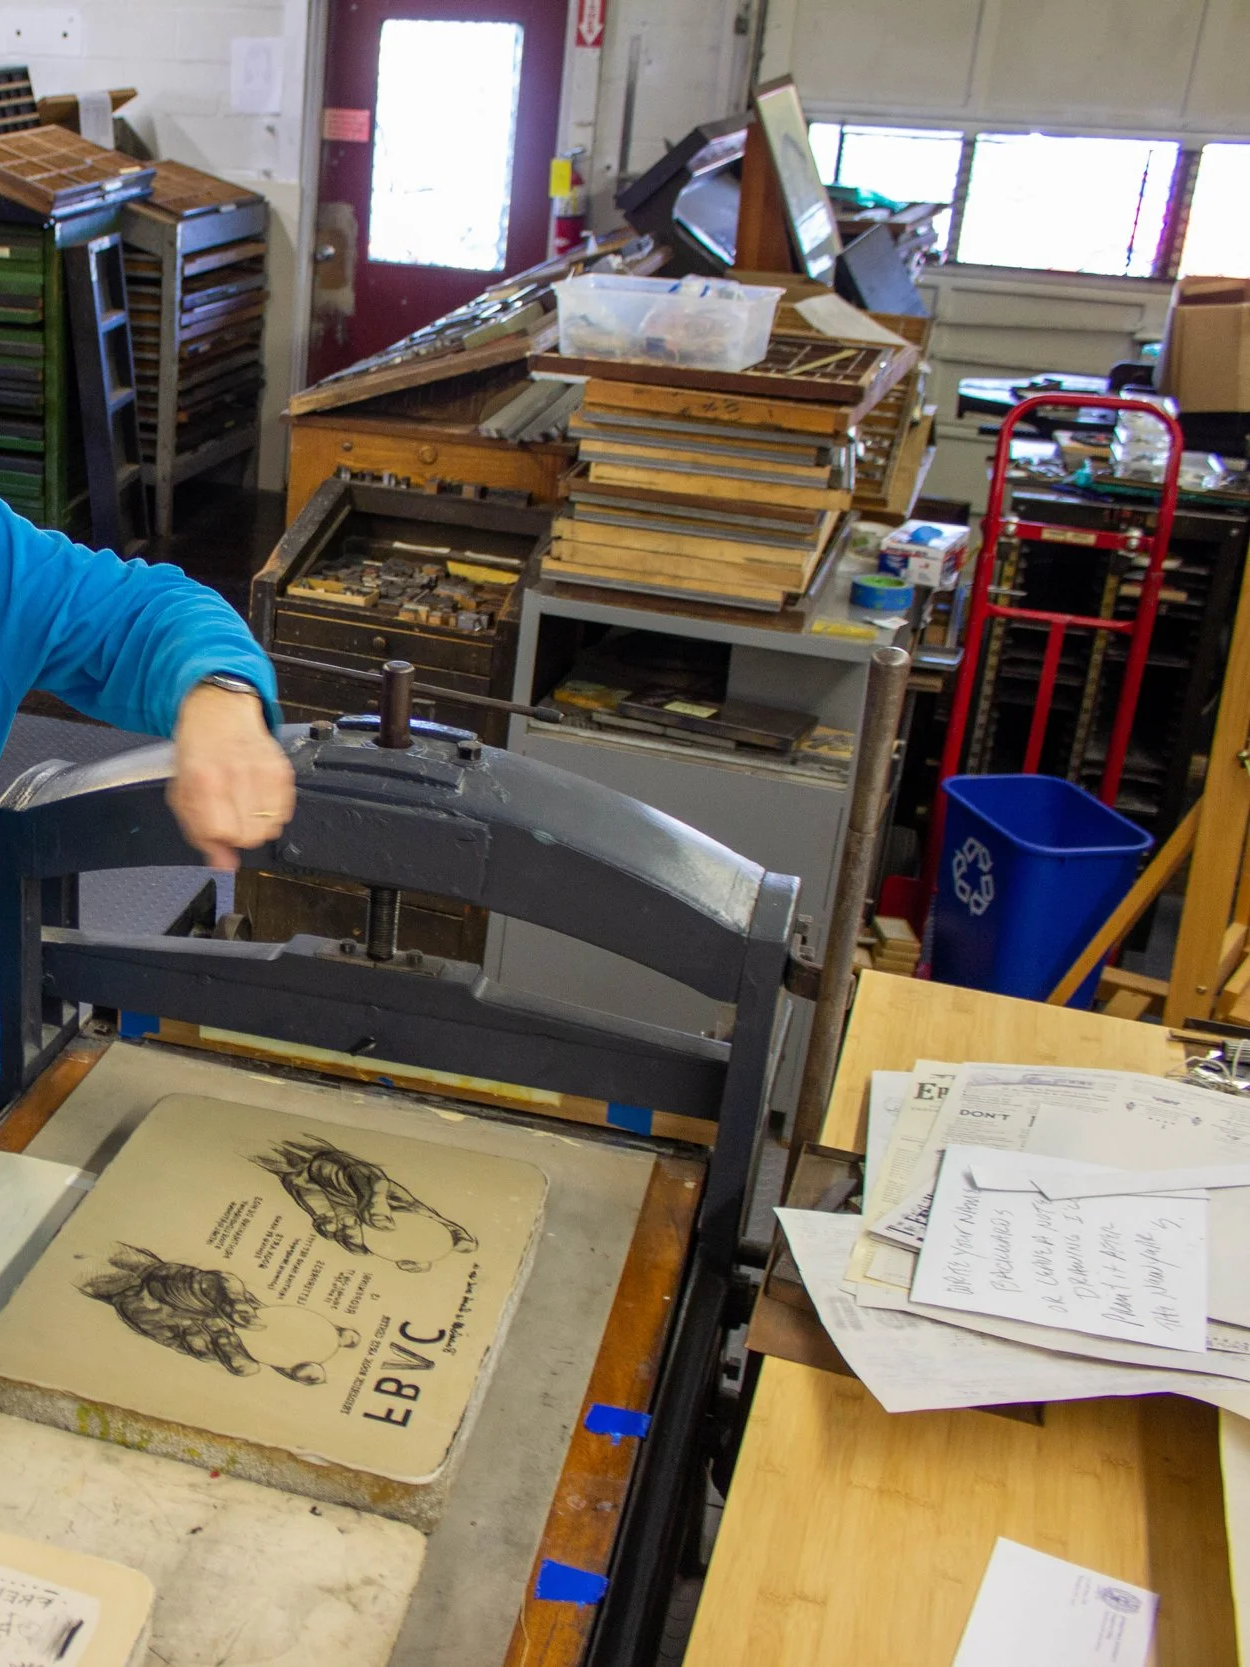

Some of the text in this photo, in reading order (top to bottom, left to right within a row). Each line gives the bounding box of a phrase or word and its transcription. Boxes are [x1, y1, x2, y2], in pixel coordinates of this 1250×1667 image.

[958, 1109, 1011, 1121] DON'T
[990, 1208, 1022, 1293] BACKWARDS
[1067, 1232, 1101, 1301] DRAWING
